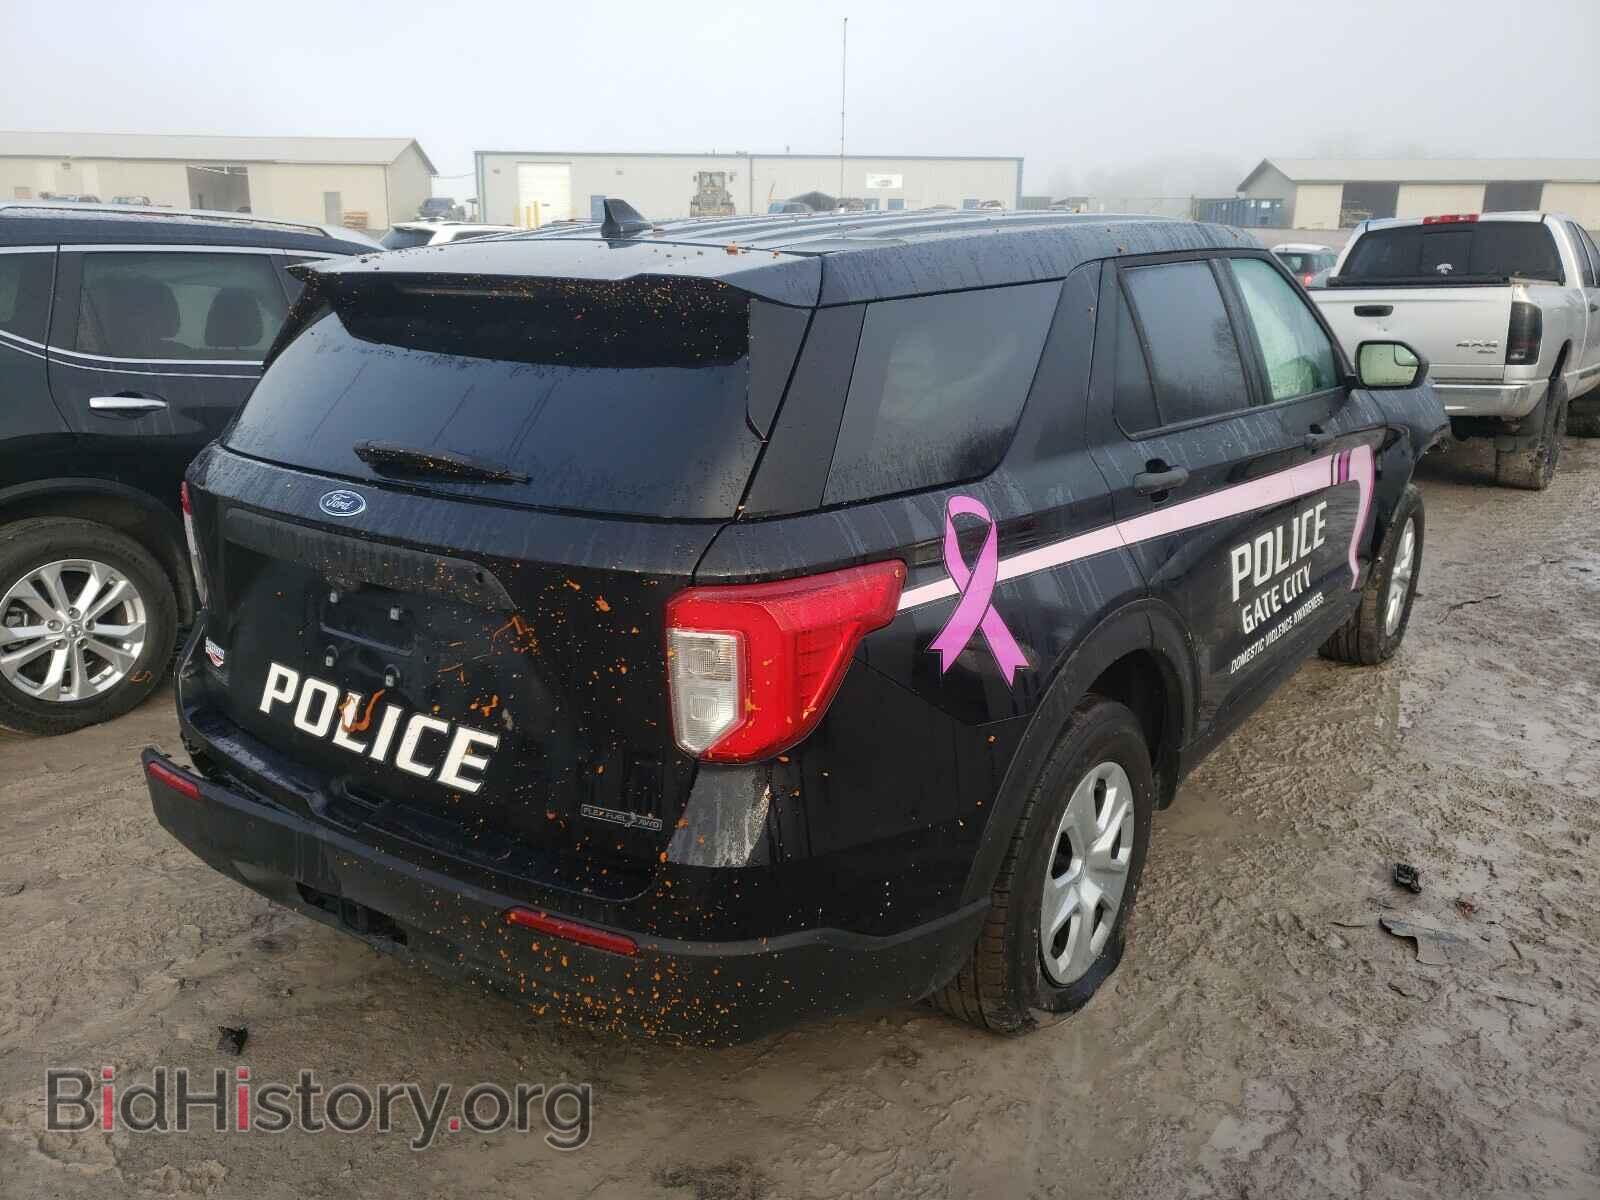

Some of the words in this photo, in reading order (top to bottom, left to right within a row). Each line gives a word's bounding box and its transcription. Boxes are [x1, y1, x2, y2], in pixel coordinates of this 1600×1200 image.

[1230, 500, 1328, 602] POLICE
[1230, 638, 1265, 675] DOMESTIC
[1265, 615, 1294, 647] VIOLENCE
[1293, 591, 1325, 626] AWARENESS
[1241, 585, 1282, 635] GATE
[1283, 562, 1312, 604] CITY
[258, 661, 500, 794] POLICE
